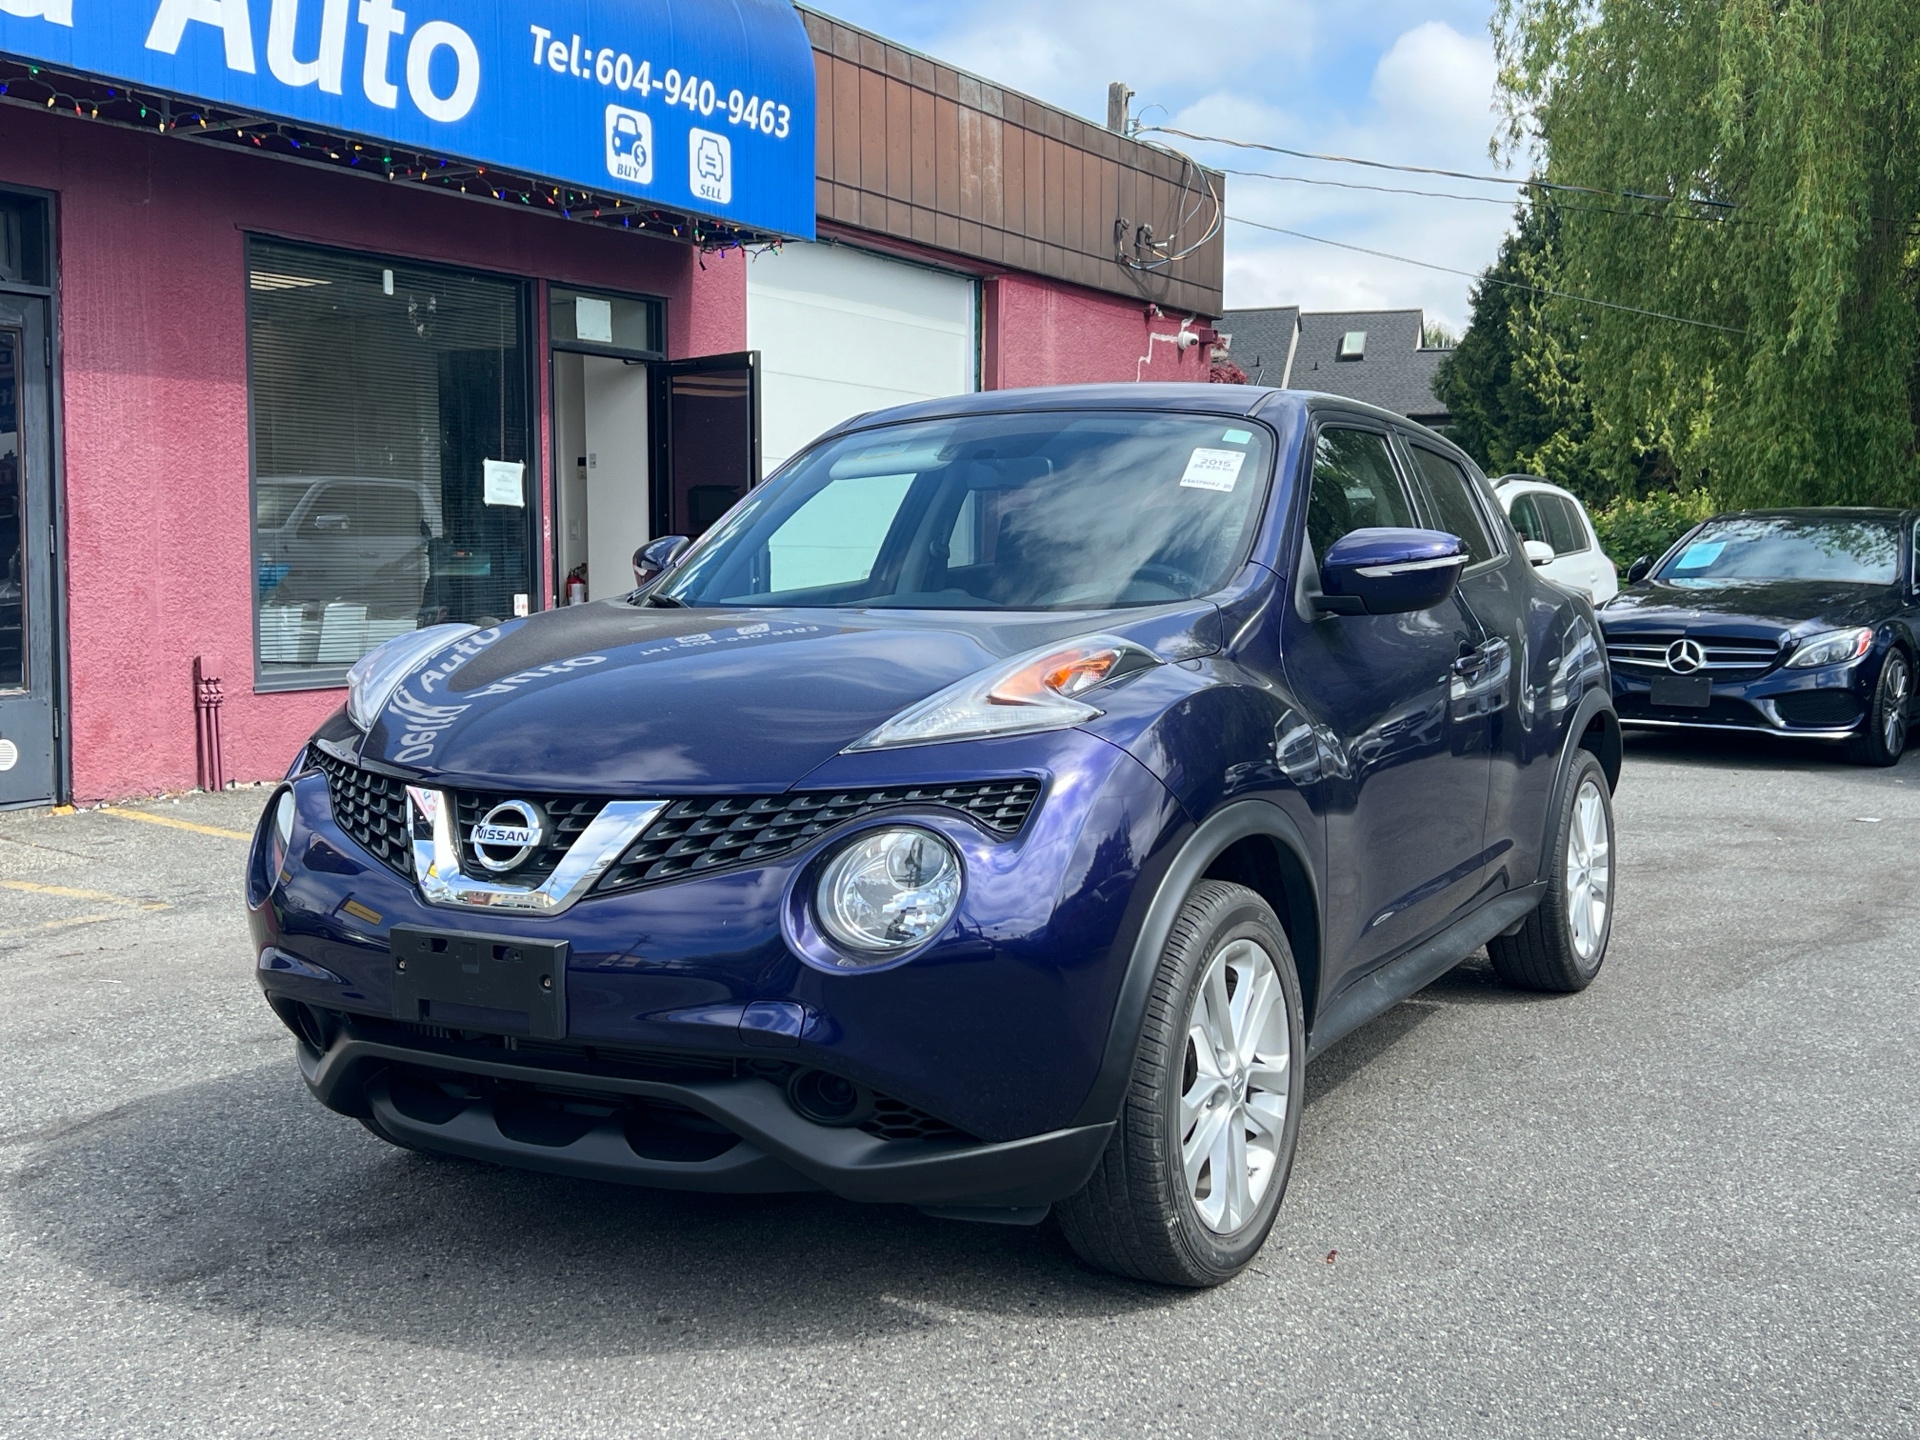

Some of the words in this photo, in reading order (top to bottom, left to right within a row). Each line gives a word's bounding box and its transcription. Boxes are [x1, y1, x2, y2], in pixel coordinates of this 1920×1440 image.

[530, 24, 791, 138] Tel:604-940-9463
[616, 163, 640, 179] BUY
[700, 184, 722, 200] SELL
[1200, 458, 1231, 468] 2015
[475, 828, 530, 842] NISSAN
